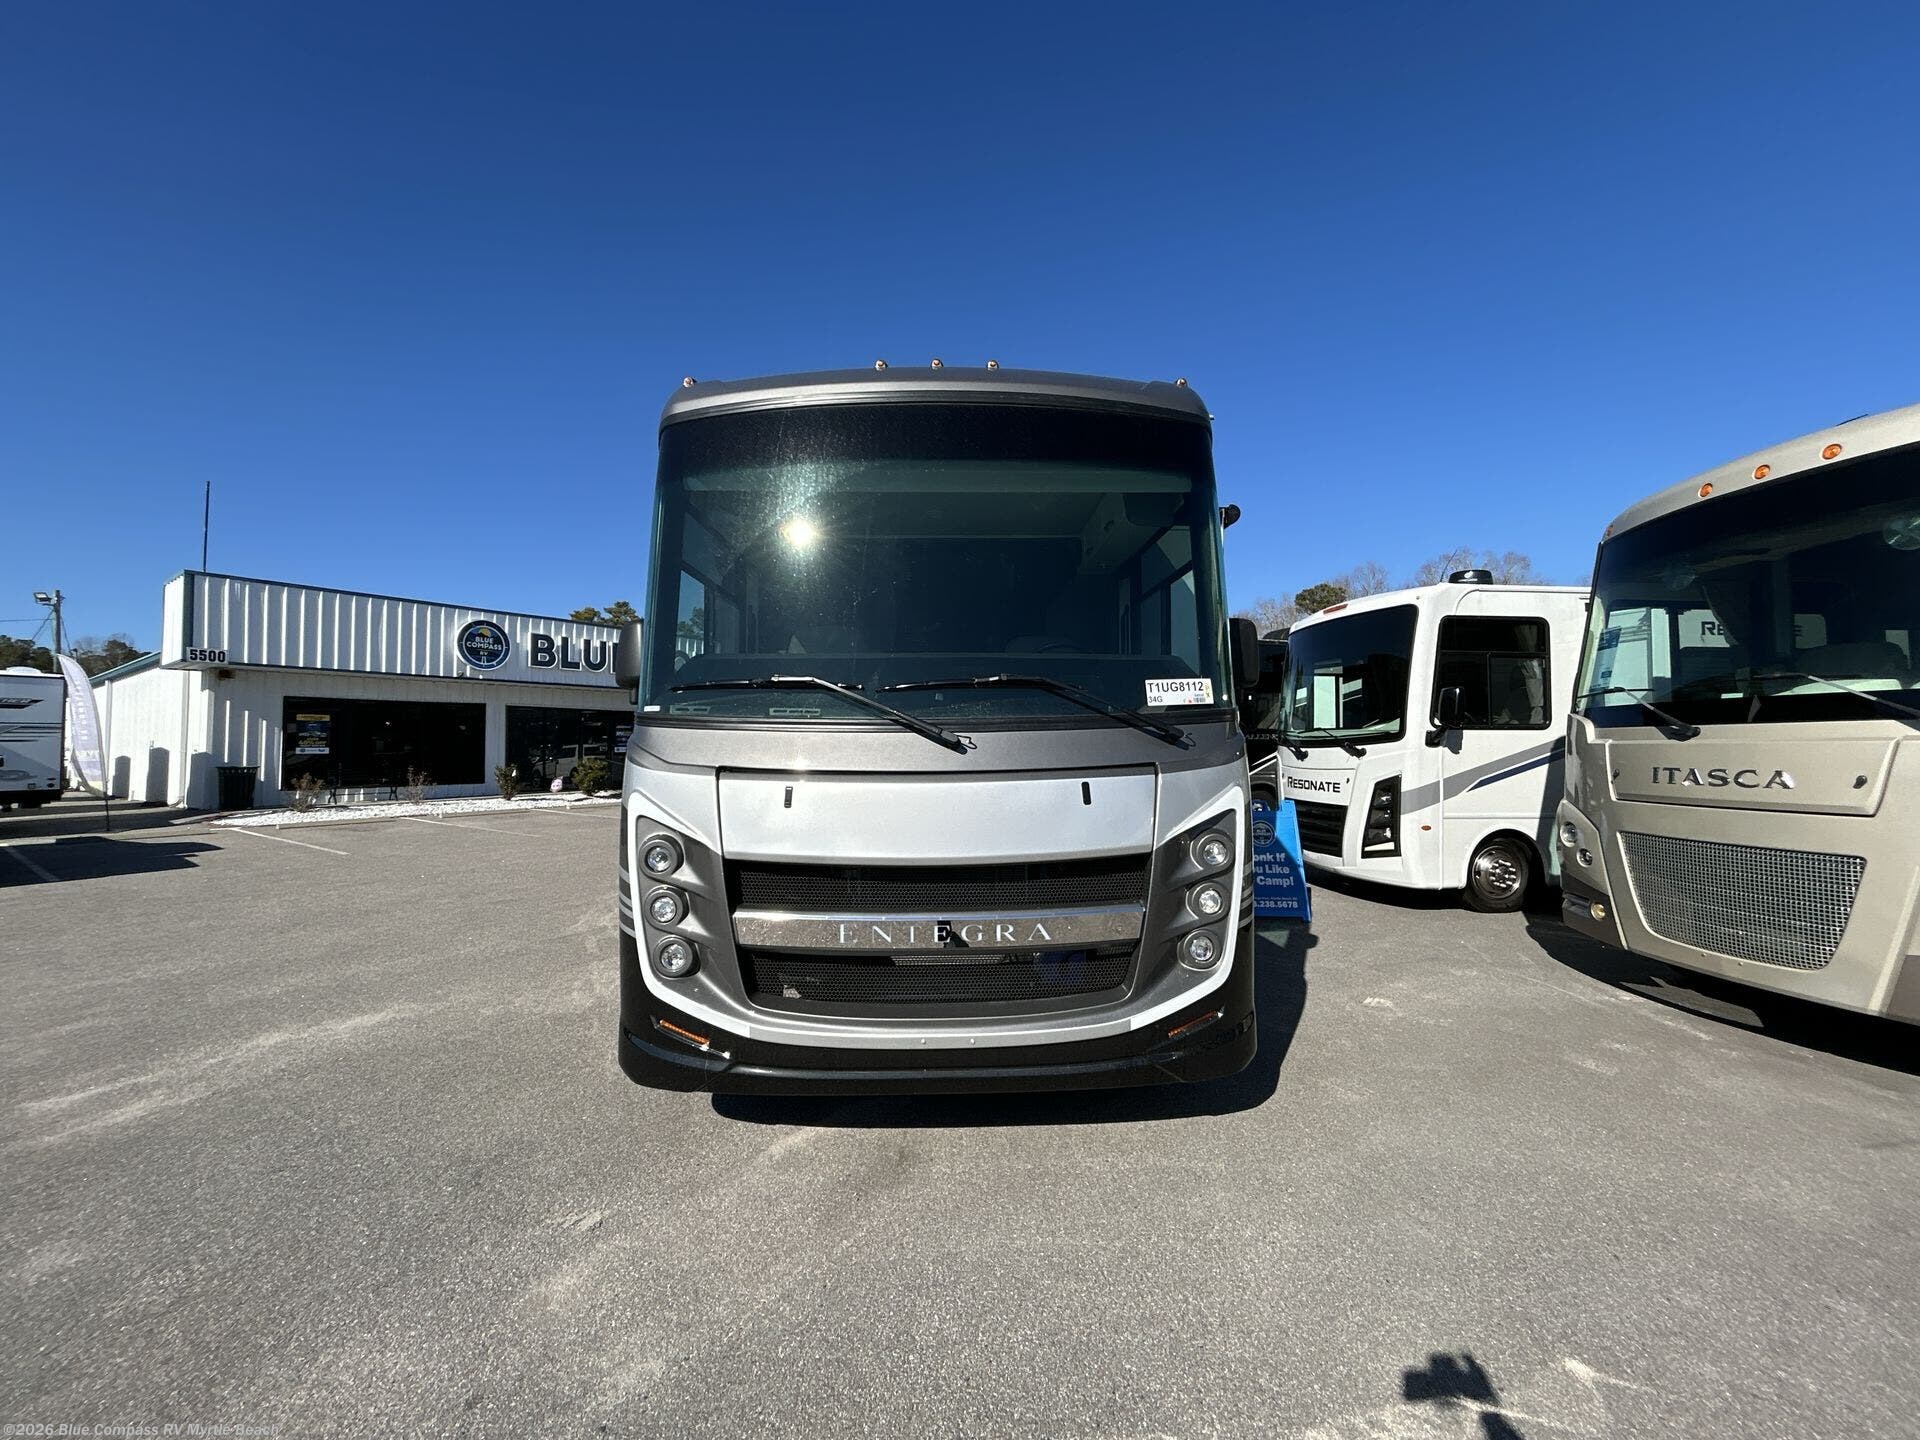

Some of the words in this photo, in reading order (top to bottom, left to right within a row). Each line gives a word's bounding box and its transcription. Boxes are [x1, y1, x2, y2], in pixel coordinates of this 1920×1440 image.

[475, 636, 494, 644] BLUE
[466, 642, 502, 651] COMPASS
[189, 648, 226, 663] 5500
[529, 632, 618, 674] BLU
[1147, 681, 1204, 693] T1UG8112
[1148, 695, 1163, 703] 34G
[1652, 766, 1795, 790] ITASCA
[1287, 776, 1341, 793] RESONATE
[1253, 852, 1274, 862] onk
[1276, 852, 1286, 862] If
[1265, 864, 1290, 874] Like
[1256, 876, 1294, 888] Camp!
[839, 922, 1051, 944] ENTEGRA
